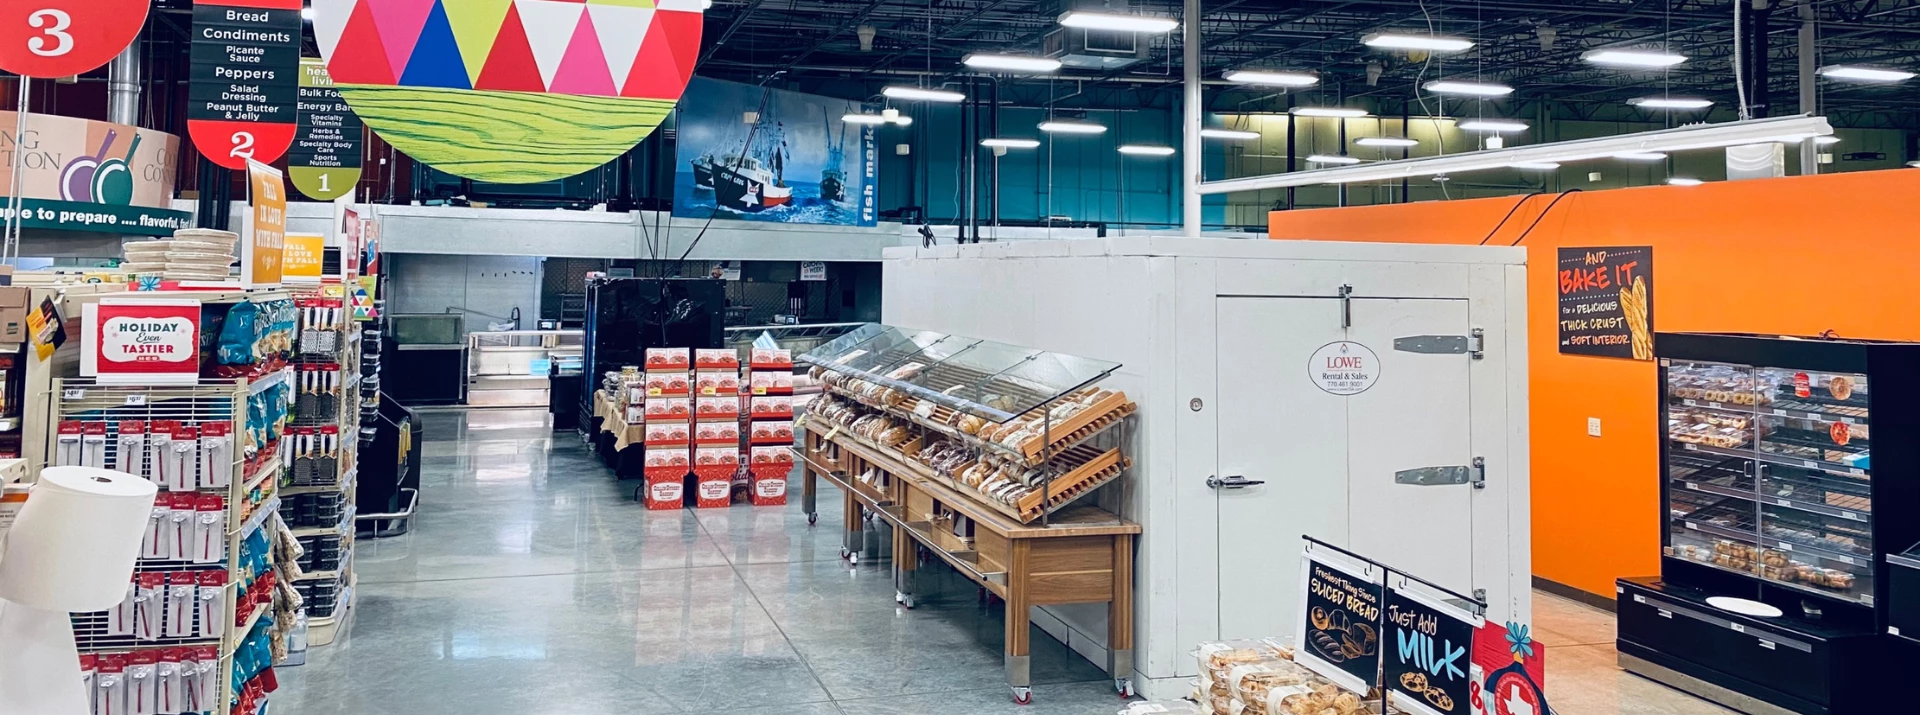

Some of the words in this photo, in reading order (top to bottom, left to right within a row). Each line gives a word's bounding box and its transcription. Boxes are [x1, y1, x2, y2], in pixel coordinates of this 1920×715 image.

[226, 9, 269, 22] Bread
[27, 8, 75, 57] 3
[203, 28, 291, 42] Condiments
[226, 45, 264, 55] Picante
[229, 54, 260, 63] Sauce
[215, 66, 275, 80] Peppers
[230, 84, 259, 93] Salad
[300, 88, 322, 97] Bulk
[221, 92, 266, 103] Dressing
[206, 102, 242, 112] Peanut
[246, 103, 279, 113] Butter
[297, 102, 332, 112] Energy
[225, 111, 232, 119] &
[236, 111, 260, 121] Jelly
[229, 131, 255, 158] 2
[299, 140, 332, 148] Specialty
[318, 173, 331, 192] 1
[863, 184, 873, 222] fish
[37, 207, 56, 220] to
[59, 211, 117, 225] prepare
[139, 214, 179, 229] flavorful,
[1585, 251, 1607, 265] AND
[1559, 266, 1610, 294] BAKE
[1615, 261, 1638, 286] IT
[1562, 306, 1571, 315] for
[1576, 301, 1618, 314] DELICIOUS
[119, 323, 178, 332] HOLIDAY
[1560, 319, 1588, 331] THICK
[1590, 317, 1624, 330] CRUST
[135, 332, 162, 344] Even
[1570, 335, 1591, 345] SOFT
[1592, 334, 1630, 345] INTERIOR.
[122, 344, 174, 353] TASTIER
[1326, 356, 1362, 368] LOWE
[1322, 372, 1343, 380] Rental
[1351, 372, 1368, 380] Sales
[1315, 566, 1341, 587] Freshest
[1340, 579, 1358, 597] Thing
[1358, 587, 1376, 603] Since
[1311, 578, 1345, 605] SLICED
[1346, 595, 1379, 622] BREAD
[1388, 604, 1416, 630] Just
[1417, 613, 1437, 636] Add
[1397, 627, 1466, 682] MILK
